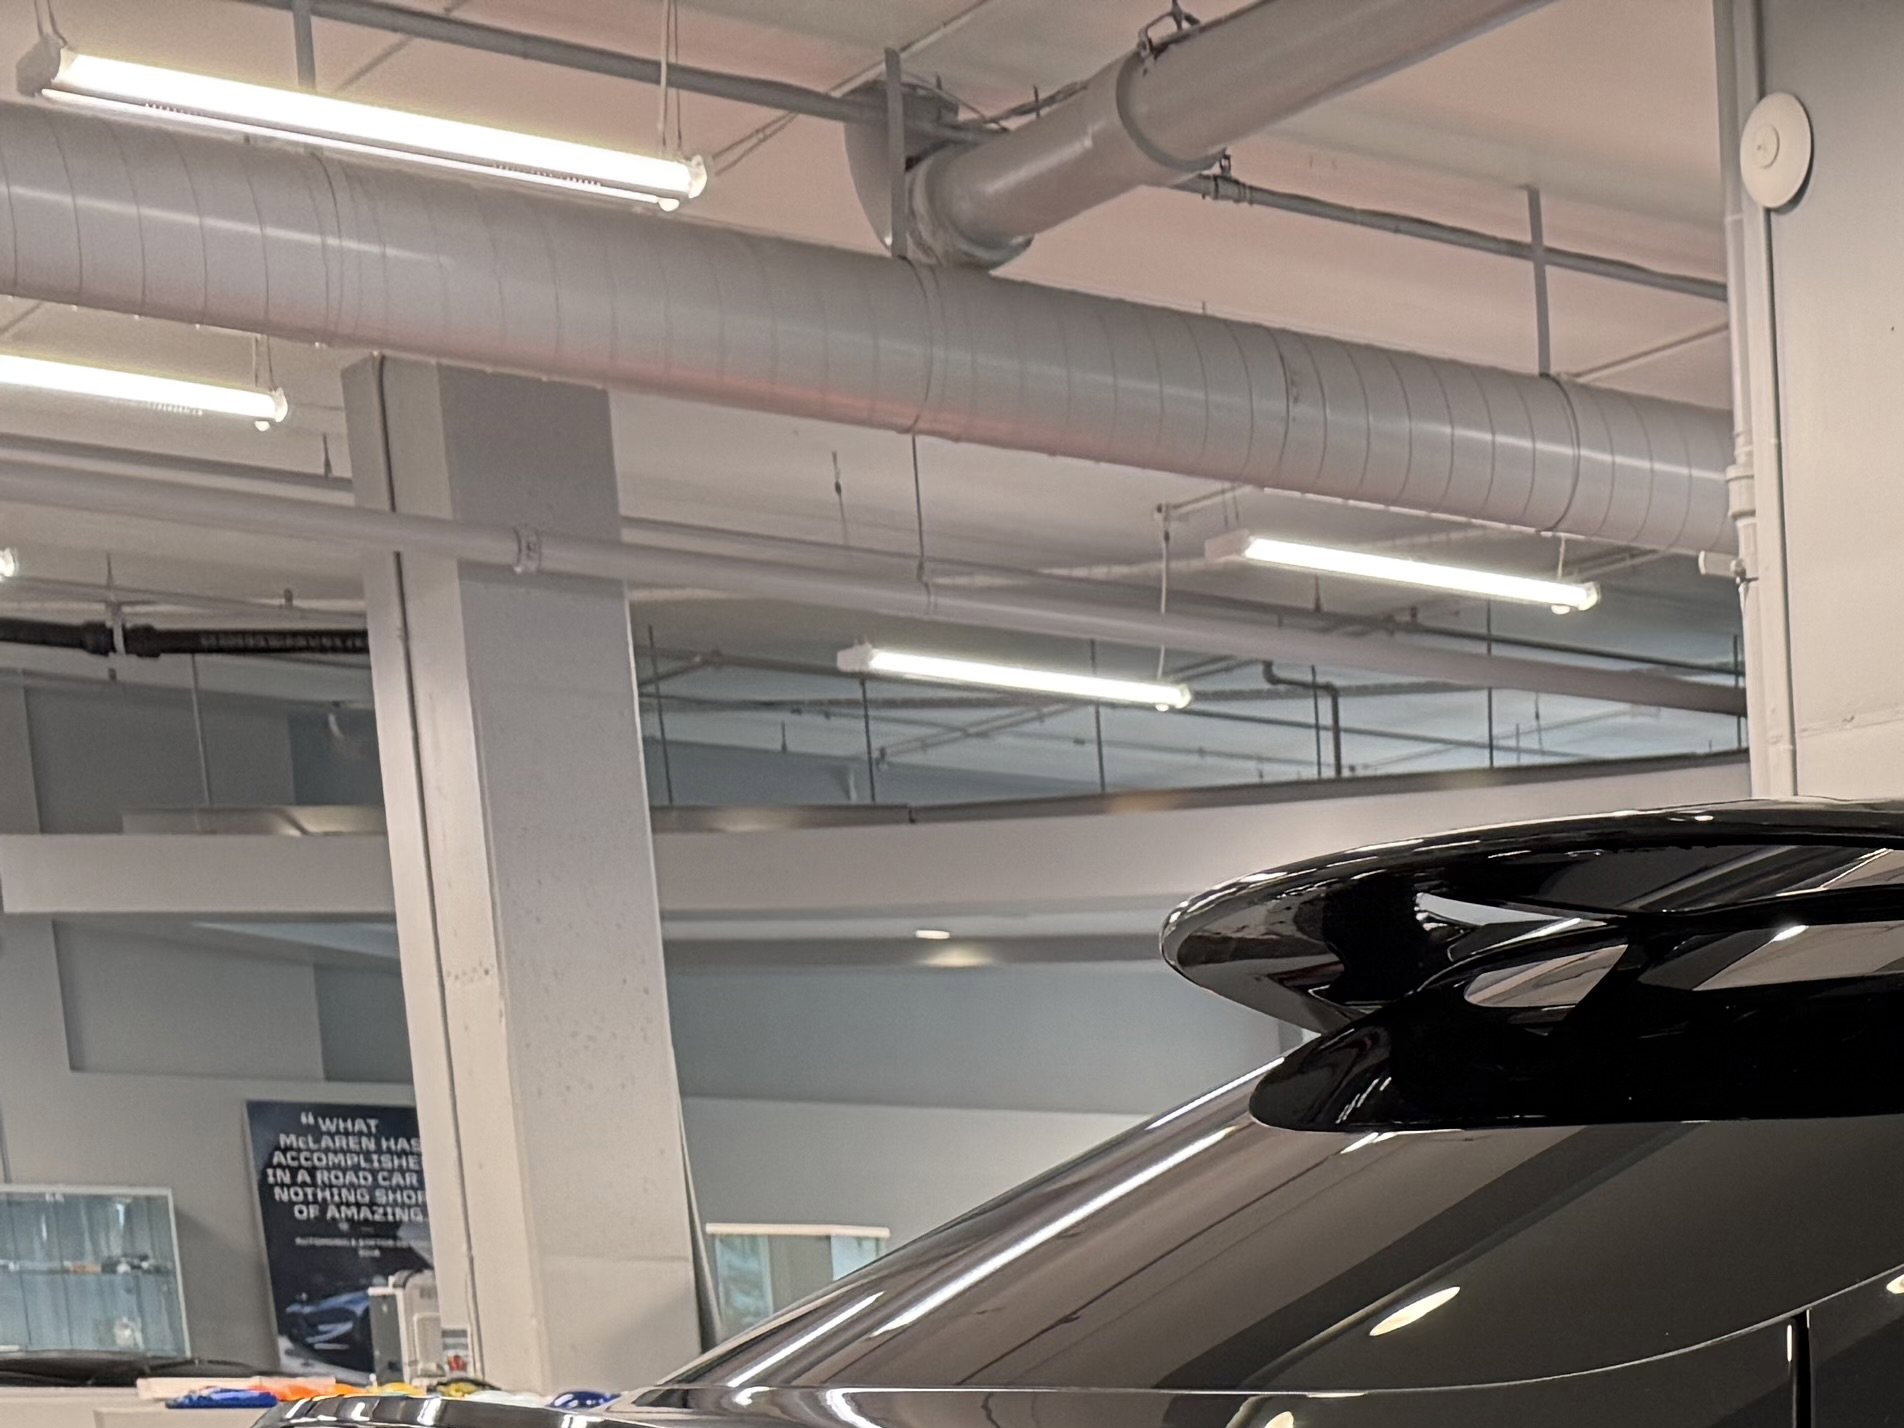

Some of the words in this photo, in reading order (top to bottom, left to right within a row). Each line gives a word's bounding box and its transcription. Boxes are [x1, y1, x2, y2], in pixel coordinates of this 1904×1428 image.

[279, 1133, 375, 1151] McLAREN
[272, 1151, 422, 1171] ACCOMPLISHE
[266, 1168, 291, 1184] IN
[297, 1170, 312, 1184] A
[316, 1170, 372, 1186] ROAD
[377, 1171, 418, 1188] CAR
[274, 1187, 369, 1204] NOTHING
[294, 1204, 320, 1220] OF
